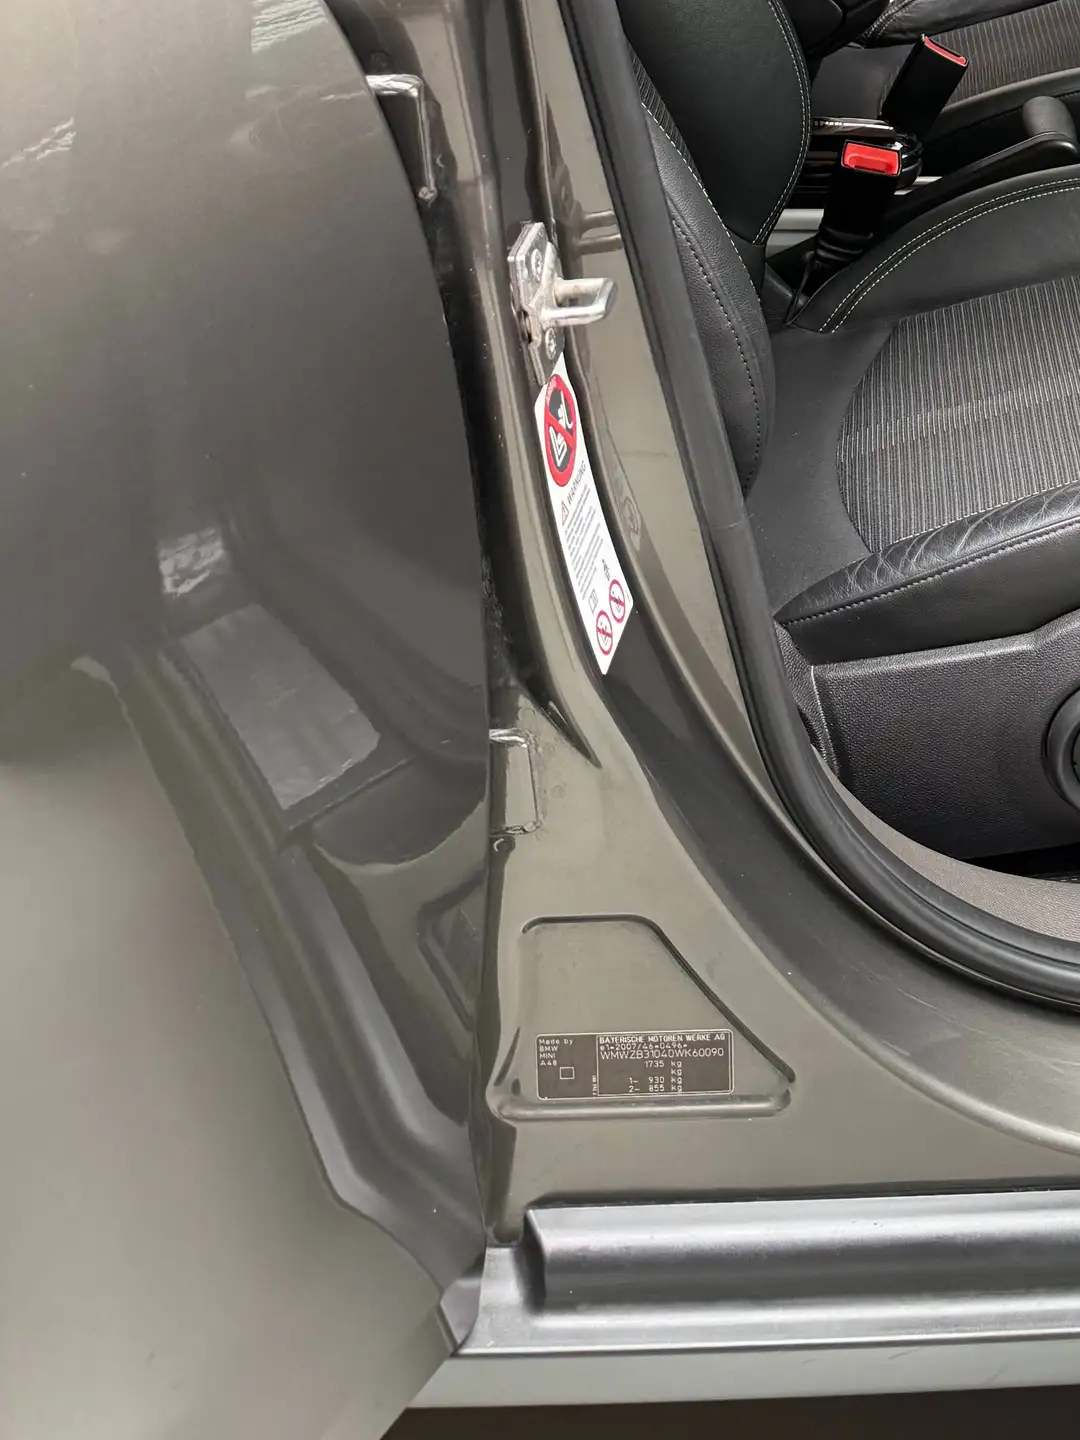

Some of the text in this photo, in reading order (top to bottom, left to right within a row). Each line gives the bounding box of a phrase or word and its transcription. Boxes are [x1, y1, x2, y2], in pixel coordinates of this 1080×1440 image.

[563, 1038, 574, 1046] by
[599, 1033, 726, 1044] BAYERISCHE MOTOREN WERKE AG
[644, 1060, 683, 1069] 1735 kg
[671, 1068, 683, 1077] kg
[648, 1076, 665, 1084] 930
[671, 1076, 683, 1085] kg
[648, 1084, 665, 1092] 855
[671, 1084, 683, 1093] kg
